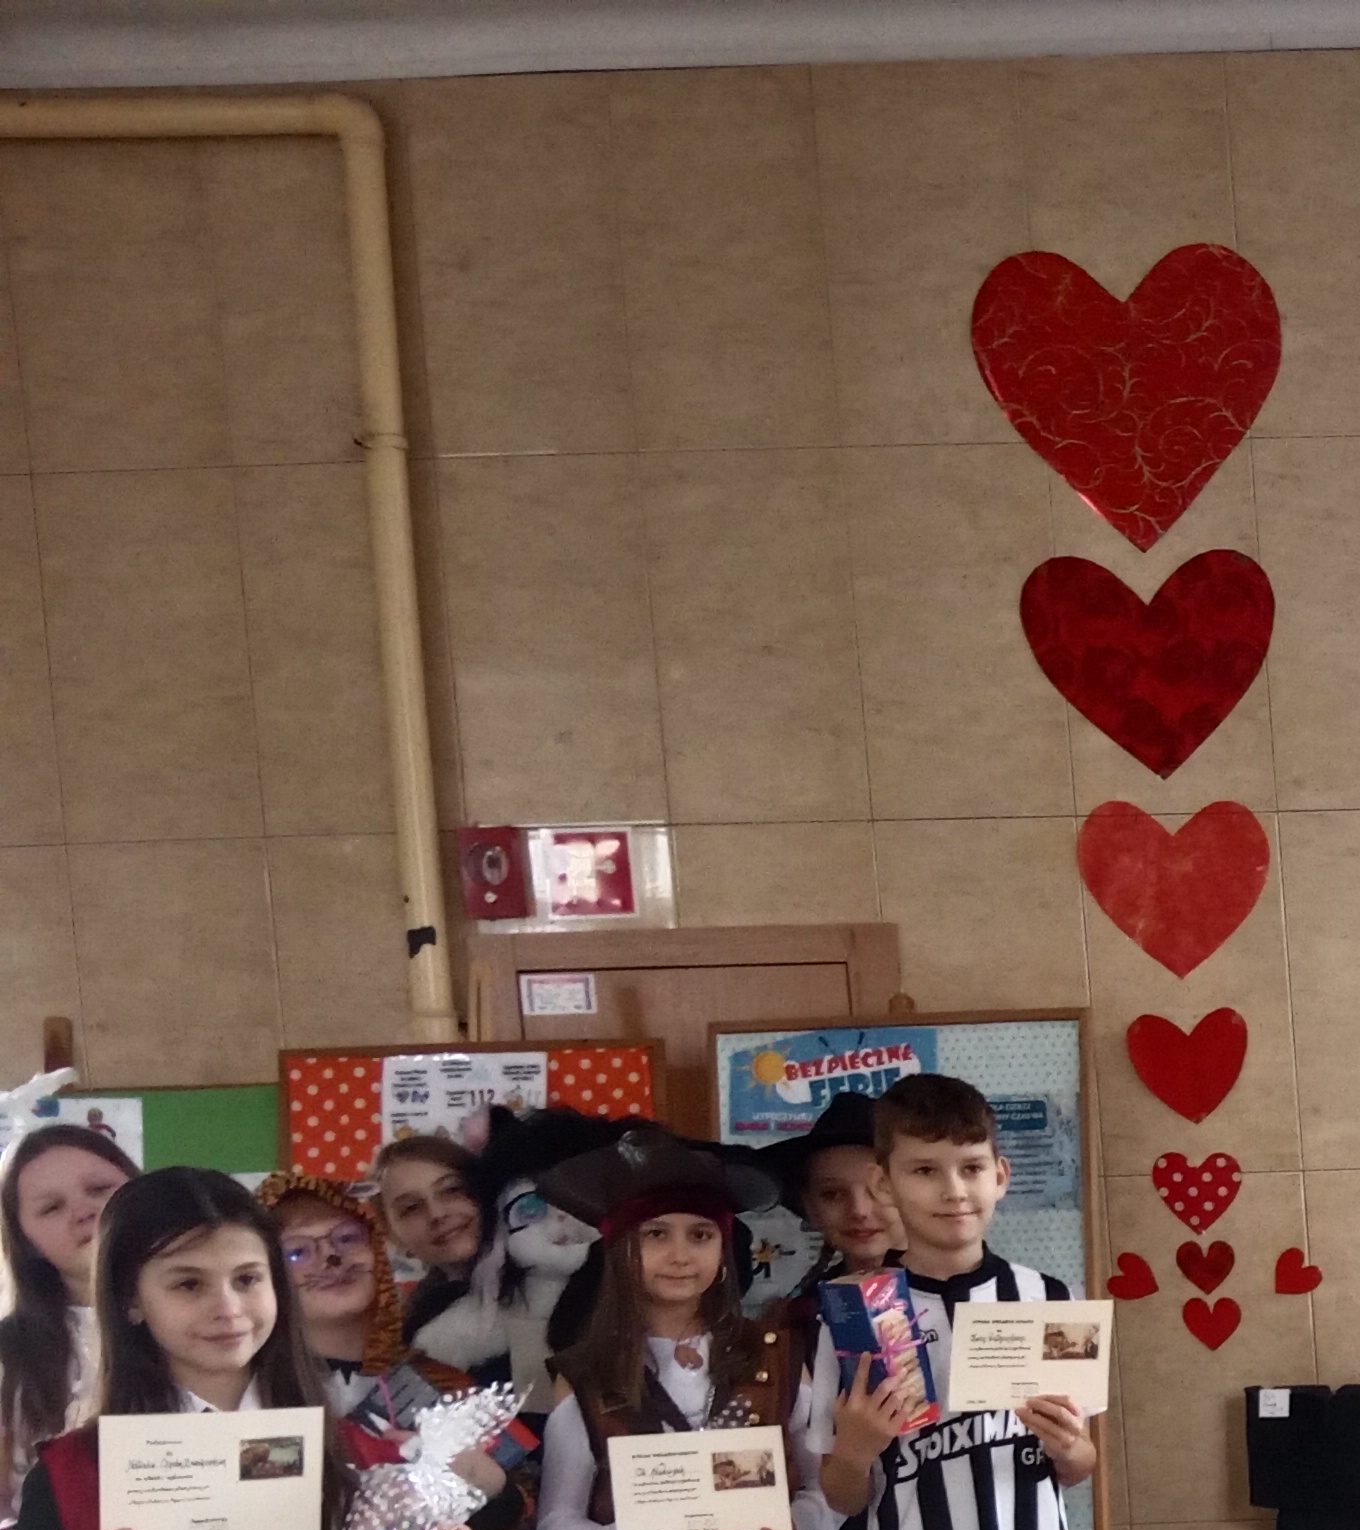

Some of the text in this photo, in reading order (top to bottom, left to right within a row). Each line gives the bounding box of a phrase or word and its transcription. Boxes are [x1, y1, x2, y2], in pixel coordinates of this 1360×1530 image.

[785, 1043, 913, 1081] BEZPIECZNE
[470, 1088, 495, 1107] 112
[895, 1410, 1035, 1479] STOIXIMA
